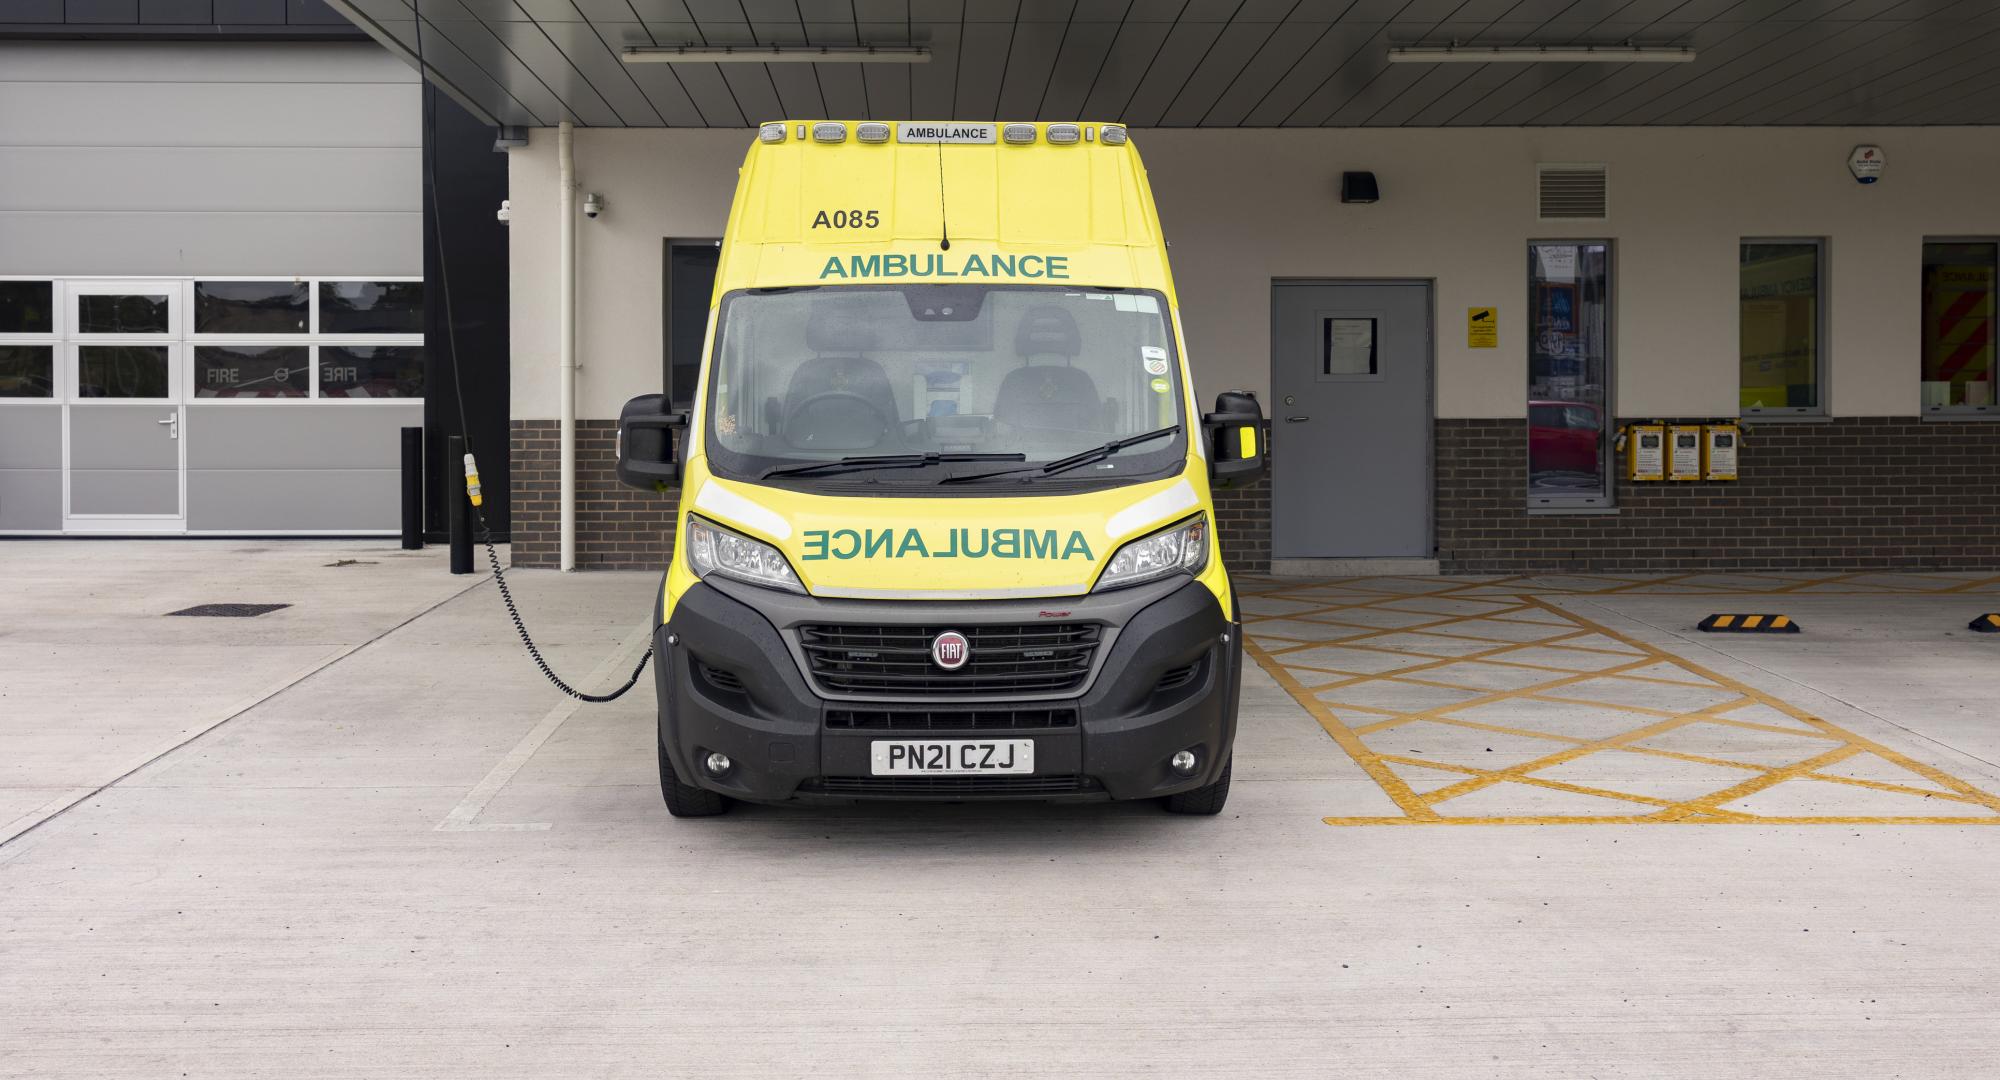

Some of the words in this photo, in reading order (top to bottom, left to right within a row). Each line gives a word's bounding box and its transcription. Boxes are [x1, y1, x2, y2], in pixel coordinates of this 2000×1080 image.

[907, 127, 988, 139] AMBULANCE
[812, 209, 880, 229] A085
[819, 253, 1070, 280] AMBULANCE
[207, 368, 240, 383] FIRE
[941, 643, 961, 659] FIAT
[889, 744, 951, 770] PN21
[960, 743, 1015, 769] CZJ
